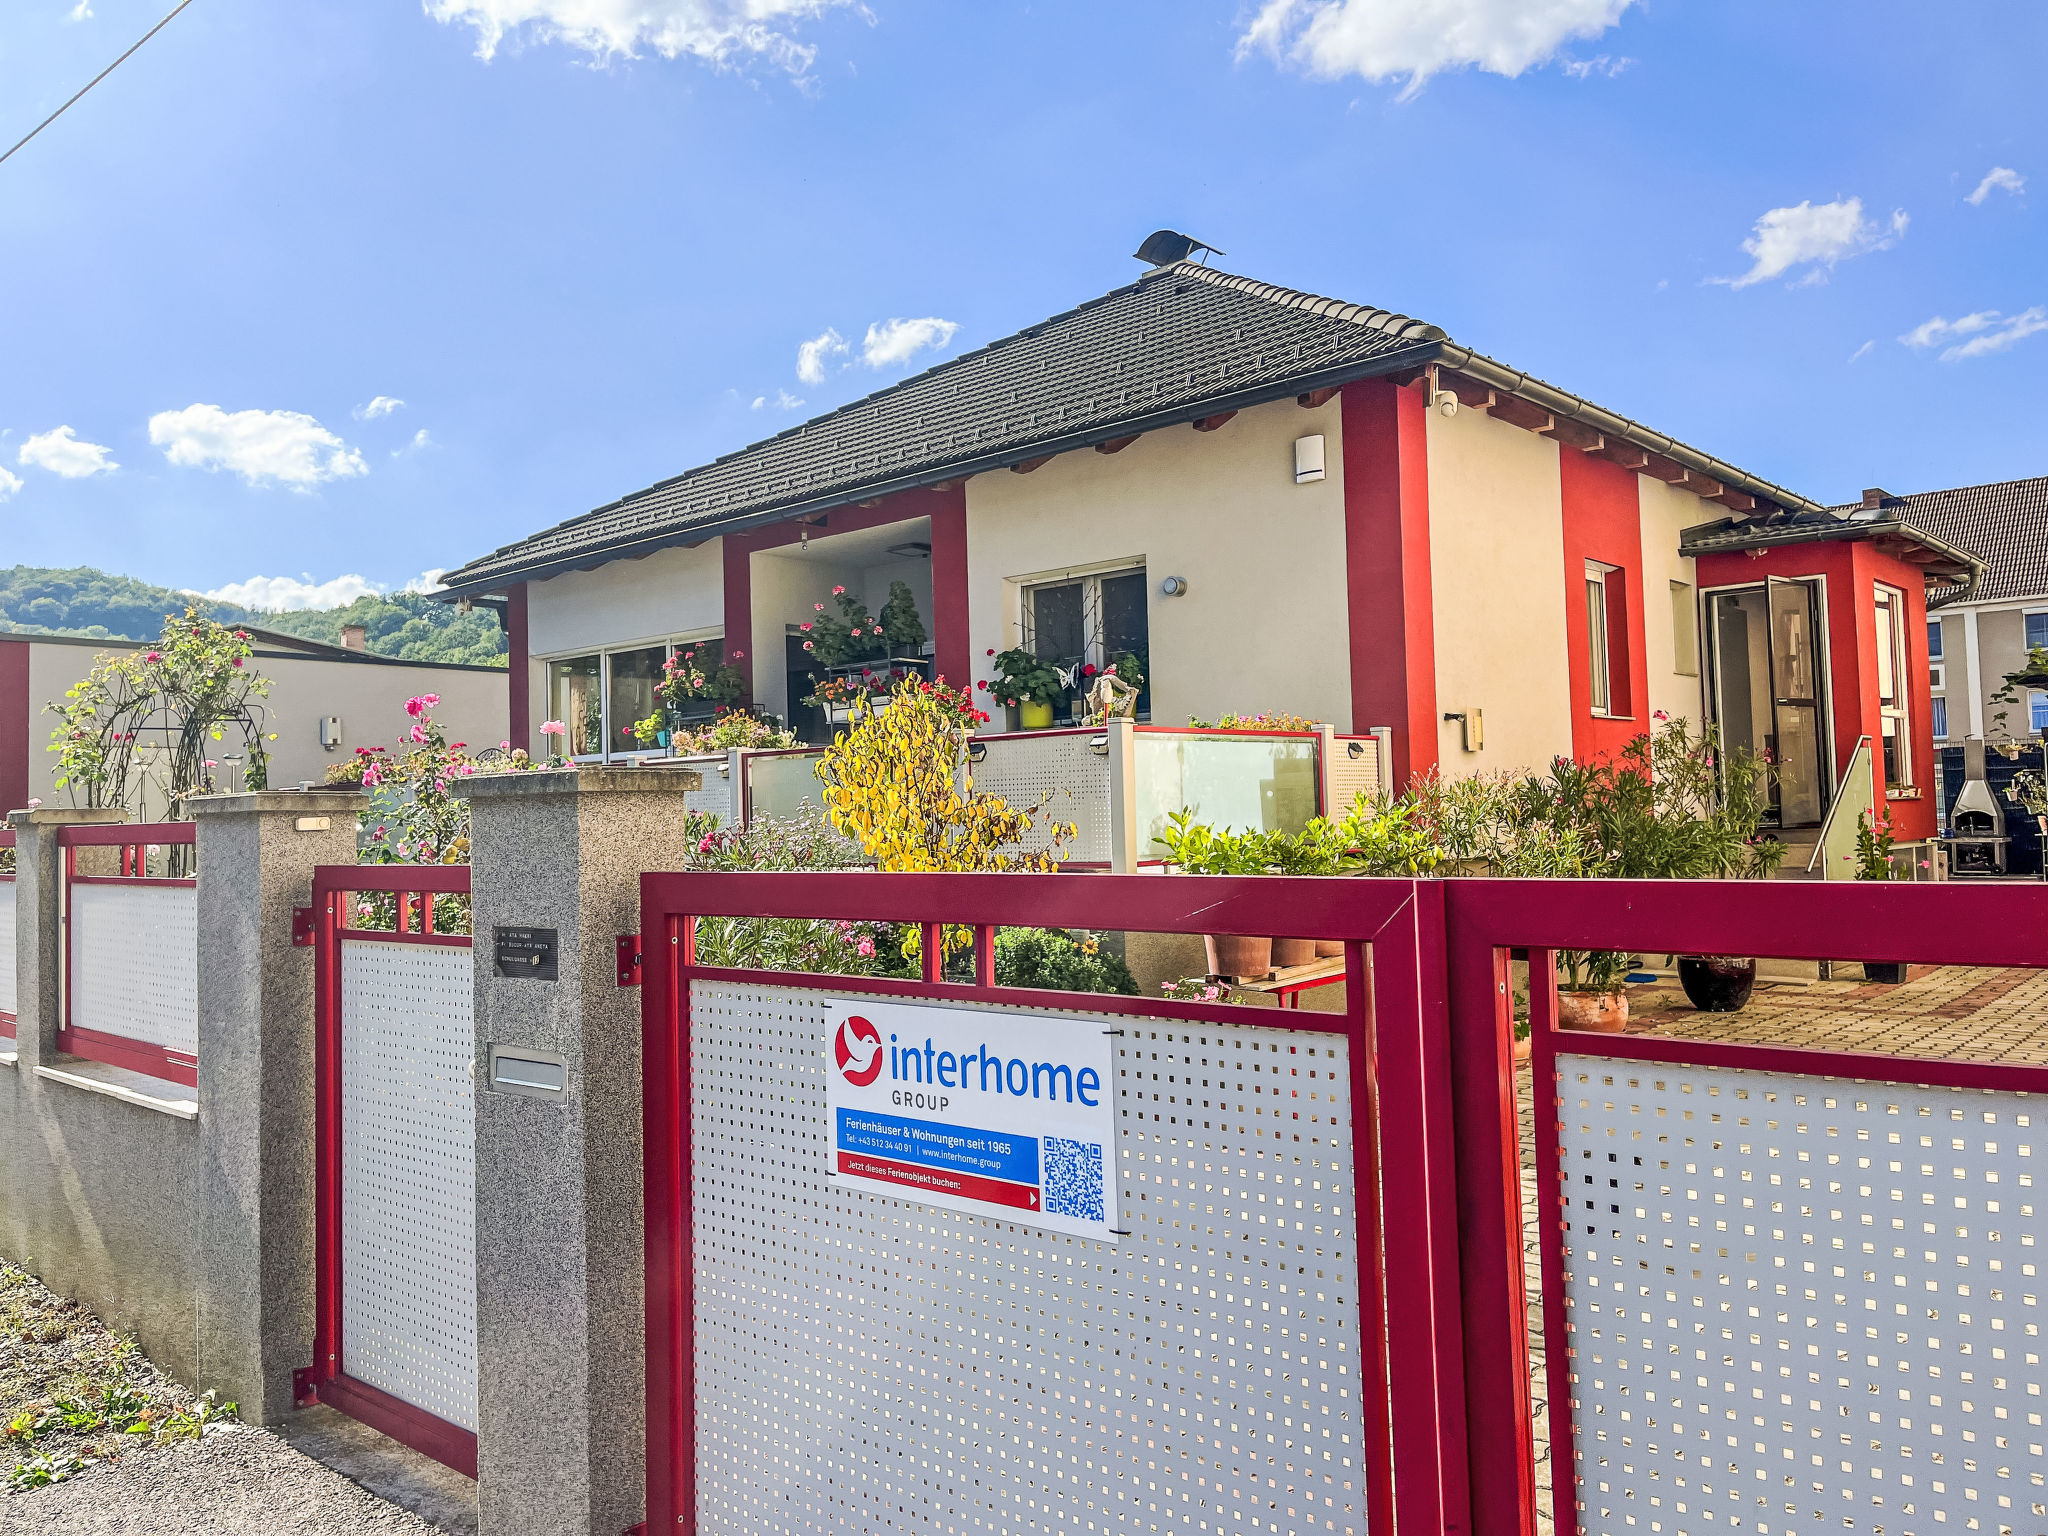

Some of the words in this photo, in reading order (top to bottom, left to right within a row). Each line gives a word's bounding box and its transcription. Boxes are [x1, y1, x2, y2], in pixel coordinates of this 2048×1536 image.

[891, 1033, 1100, 1107] interhome
[892, 1090, 949, 1112] GROUP
[846, 1117, 901, 1136] Ferienhäuser
[903, 1126, 910, 1138] &
[911, 1127, 965, 1149] Wohnungen
[967, 1138, 985, 1151] seit
[987, 1140, 1011, 1155] 1965
[858, 1137, 871, 1145] +43
[871, 1138, 884, 1148] 512
[885, 1140, 893, 1150] 34
[894, 1142, 903, 1152] 40
[904, 1143, 912, 1153] 91
[921, 1148, 1001, 1170] www.interhome.group
[848, 1160, 864, 1171] Jetzt
[865, 1163, 886, 1175] dieses
[887, 1168, 931, 1184] Ferienobjekt
[932, 1176, 961, 1190] buchen:
